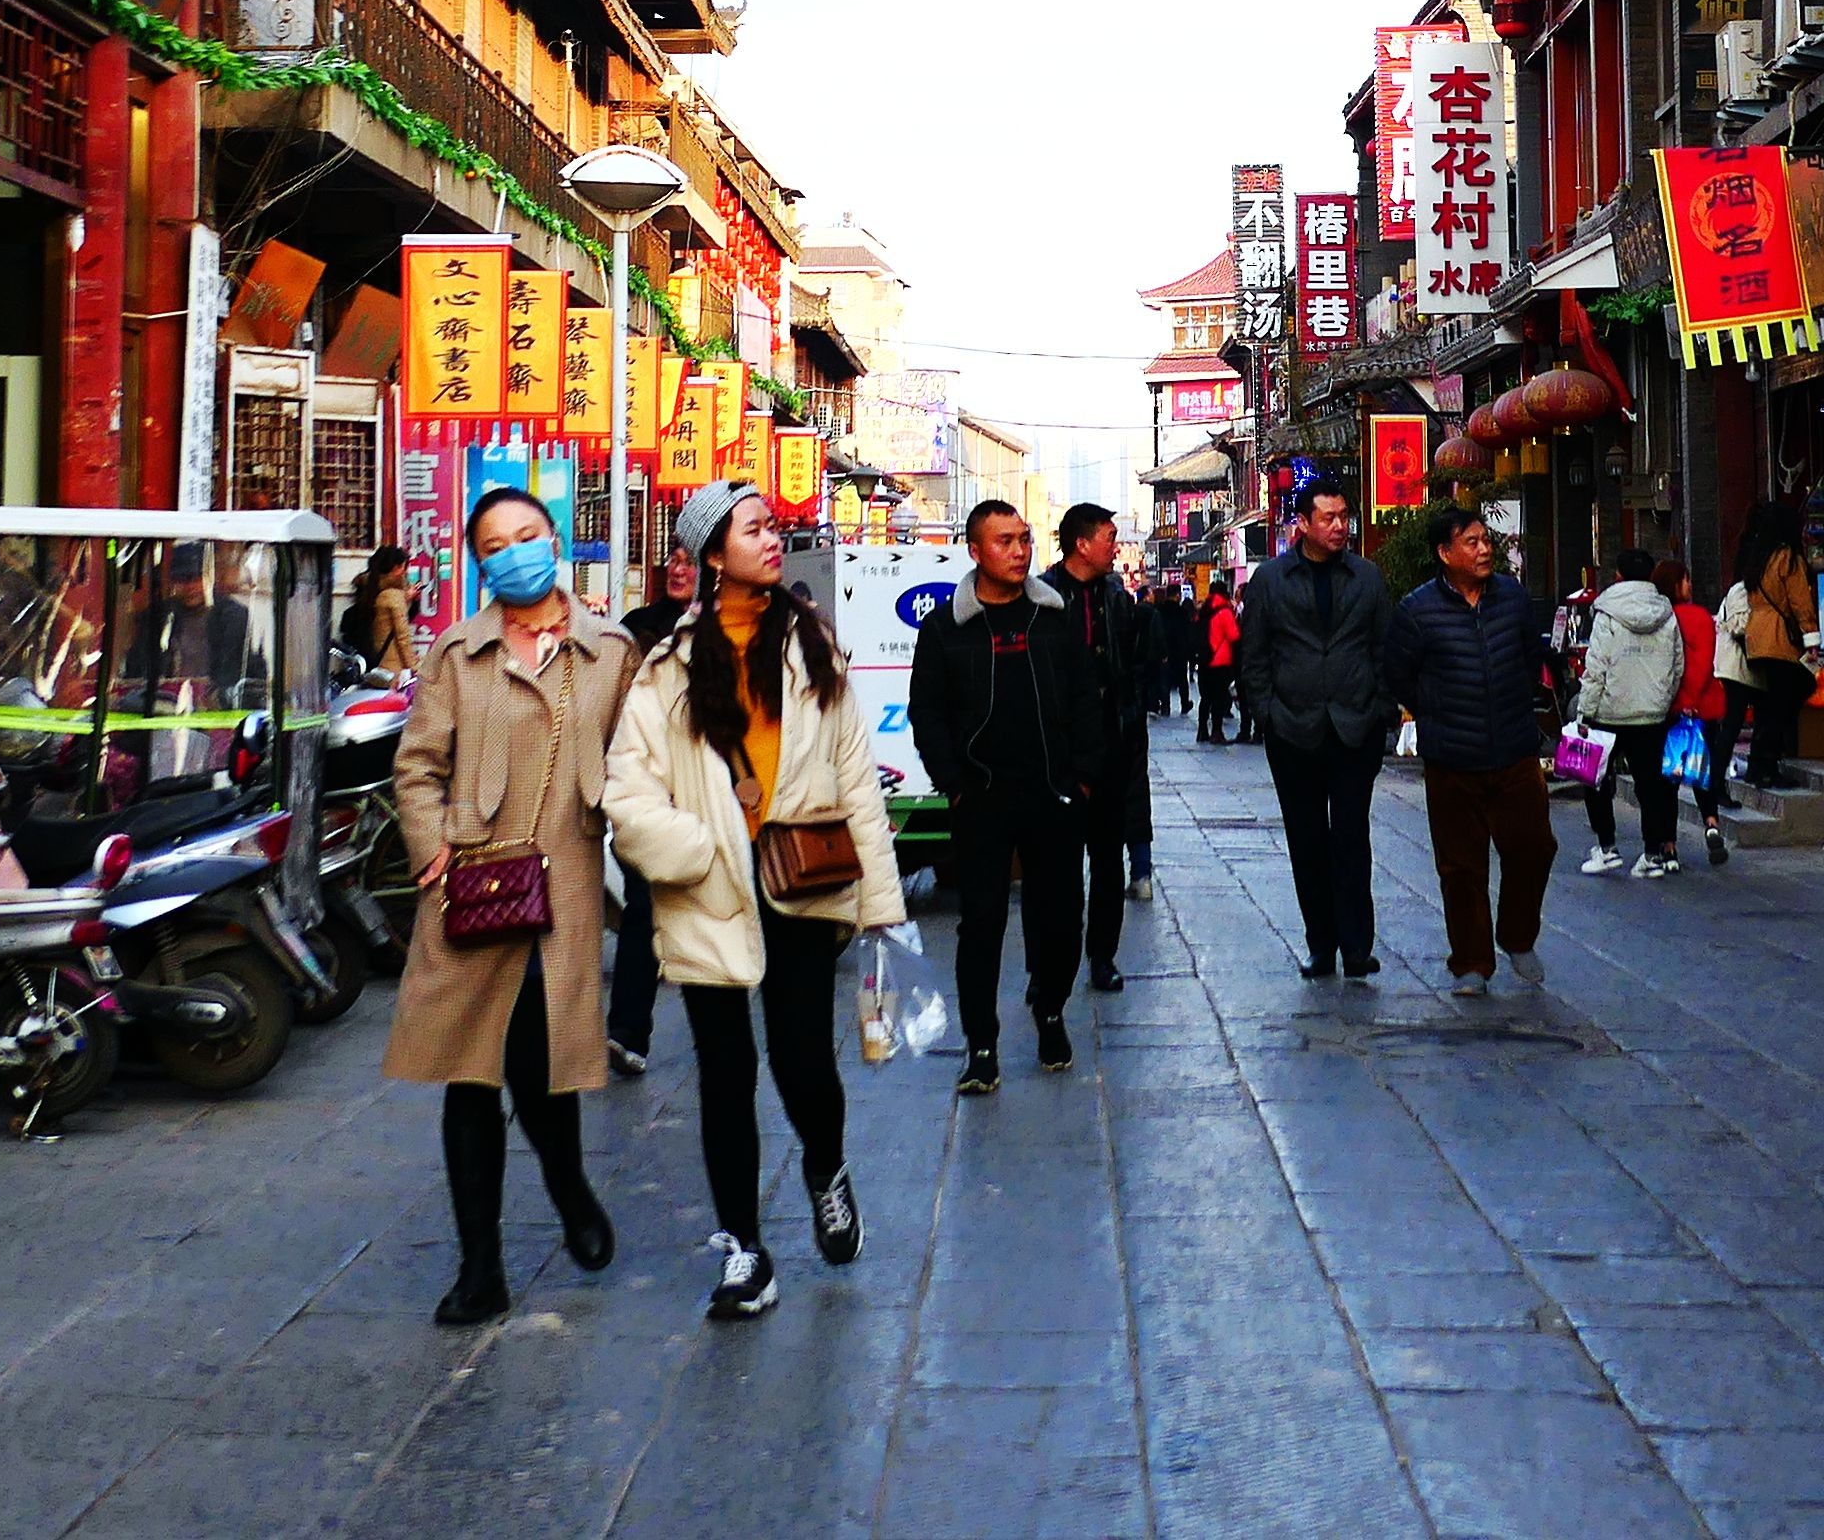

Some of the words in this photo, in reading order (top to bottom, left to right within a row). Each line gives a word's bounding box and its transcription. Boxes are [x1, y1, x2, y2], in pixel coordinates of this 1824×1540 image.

[1428, 65, 1497, 250] 杏花村
[1237, 192, 1283, 340] 不翻汤
[1303, 202, 1350, 338] 椿里巷
[1427, 259, 1503, 298] 水席
[876, 704, 909, 733] Z
